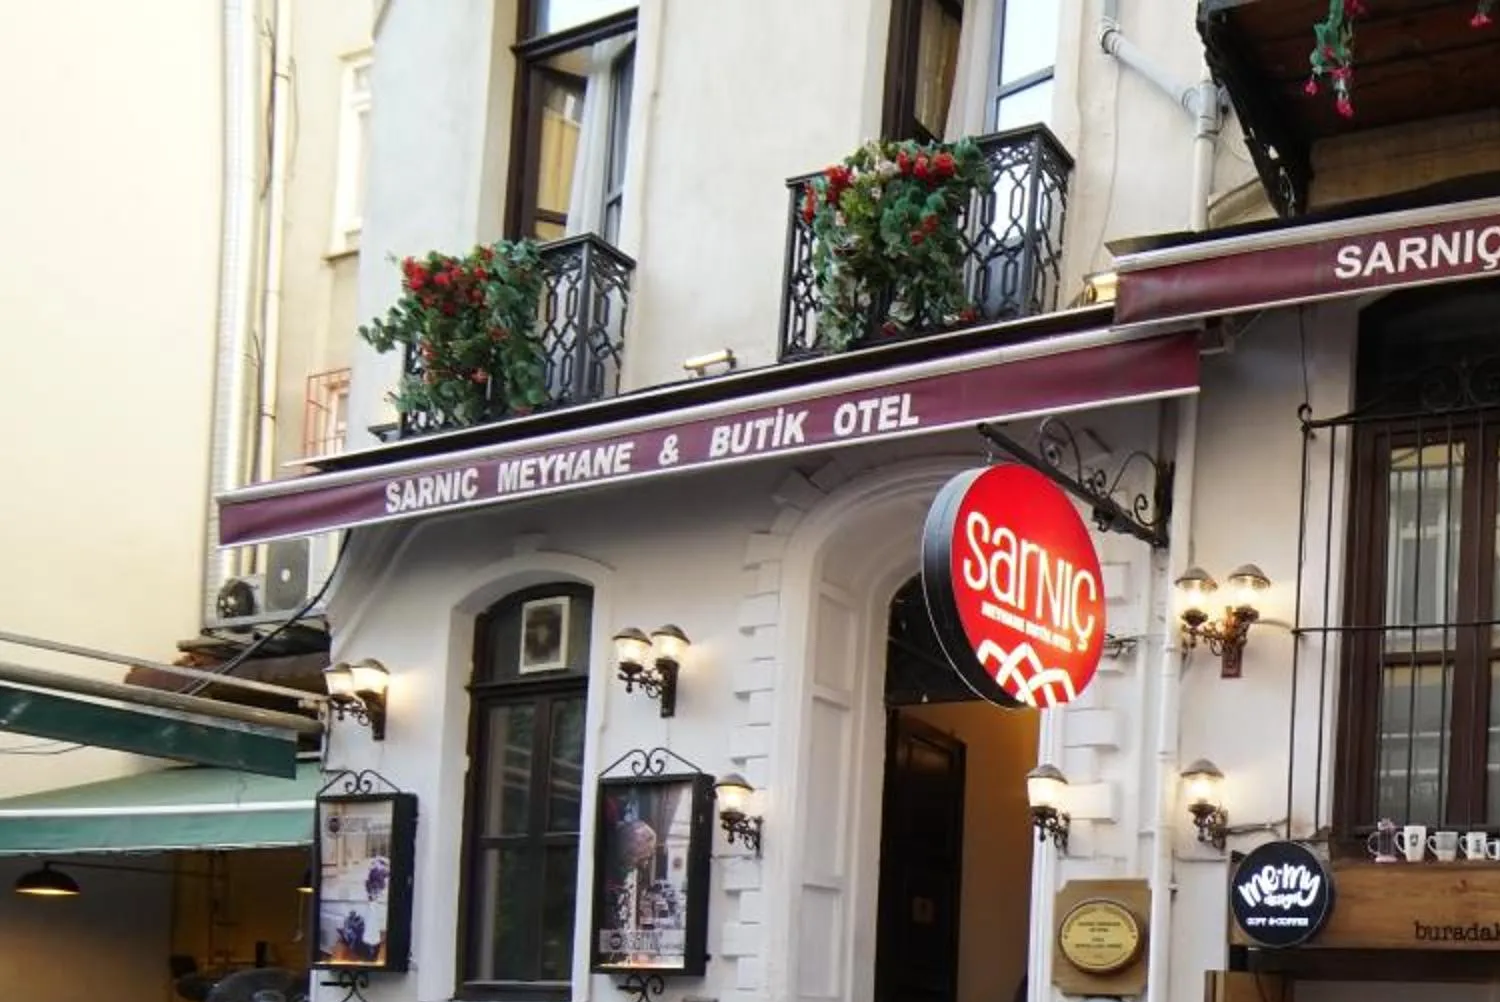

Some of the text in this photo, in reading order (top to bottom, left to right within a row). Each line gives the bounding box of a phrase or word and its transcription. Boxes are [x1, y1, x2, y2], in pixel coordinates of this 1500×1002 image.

[497, 441, 635, 493] MEYHANE
[658, 433, 679, 466] &
[709, 408, 809, 458] BUTİK
[833, 393, 919, 437] OTEL
